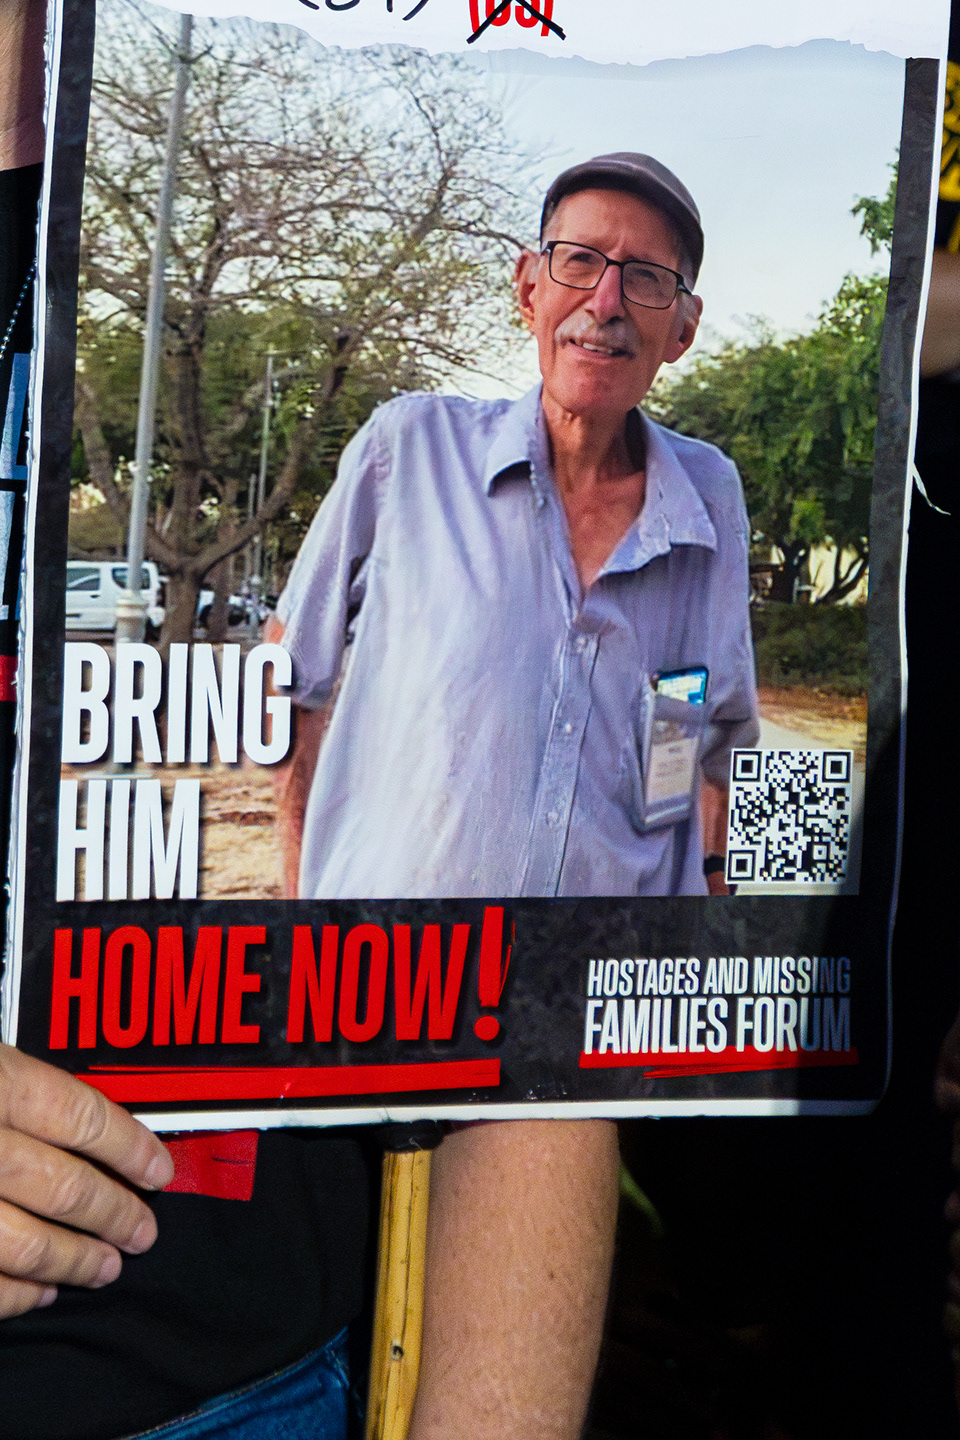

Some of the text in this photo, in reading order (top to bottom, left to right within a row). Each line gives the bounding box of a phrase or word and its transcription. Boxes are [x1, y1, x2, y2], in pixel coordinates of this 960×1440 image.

[60, 642, 292, 765] BRING
[56, 778, 201, 901] HIM
[49, 906, 515, 1050] HOME NOW!
[583, 996, 851, 1055] FAMILIES FORUM
[587, 956, 851, 997] HOSTAGES AND MISSING
